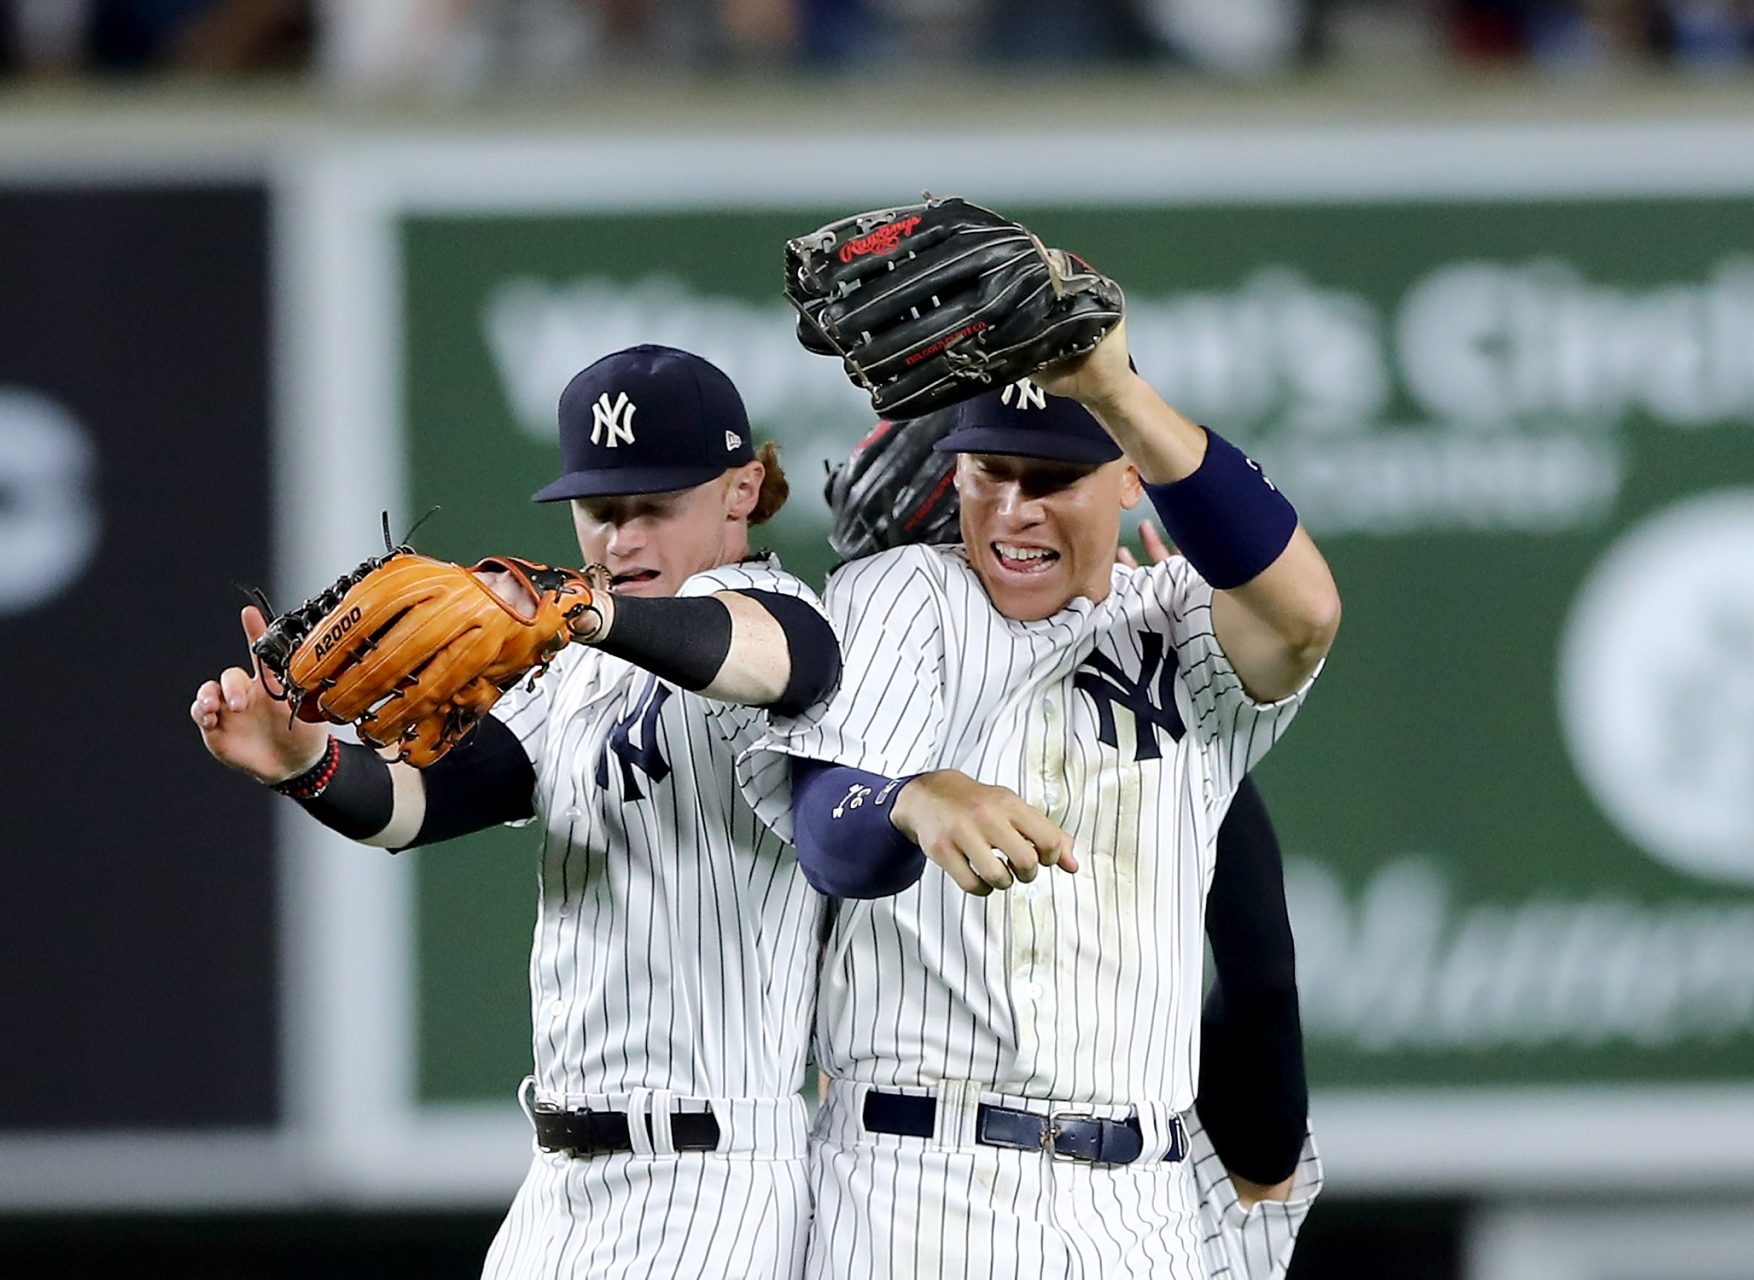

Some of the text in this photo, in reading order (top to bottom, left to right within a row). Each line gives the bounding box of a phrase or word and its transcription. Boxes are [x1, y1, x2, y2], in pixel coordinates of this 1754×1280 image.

[590, 391, 637, 448] NY
[314, 606, 362, 662] A2000
[596, 673, 673, 803] NY
[1073, 629, 1187, 762] NY
